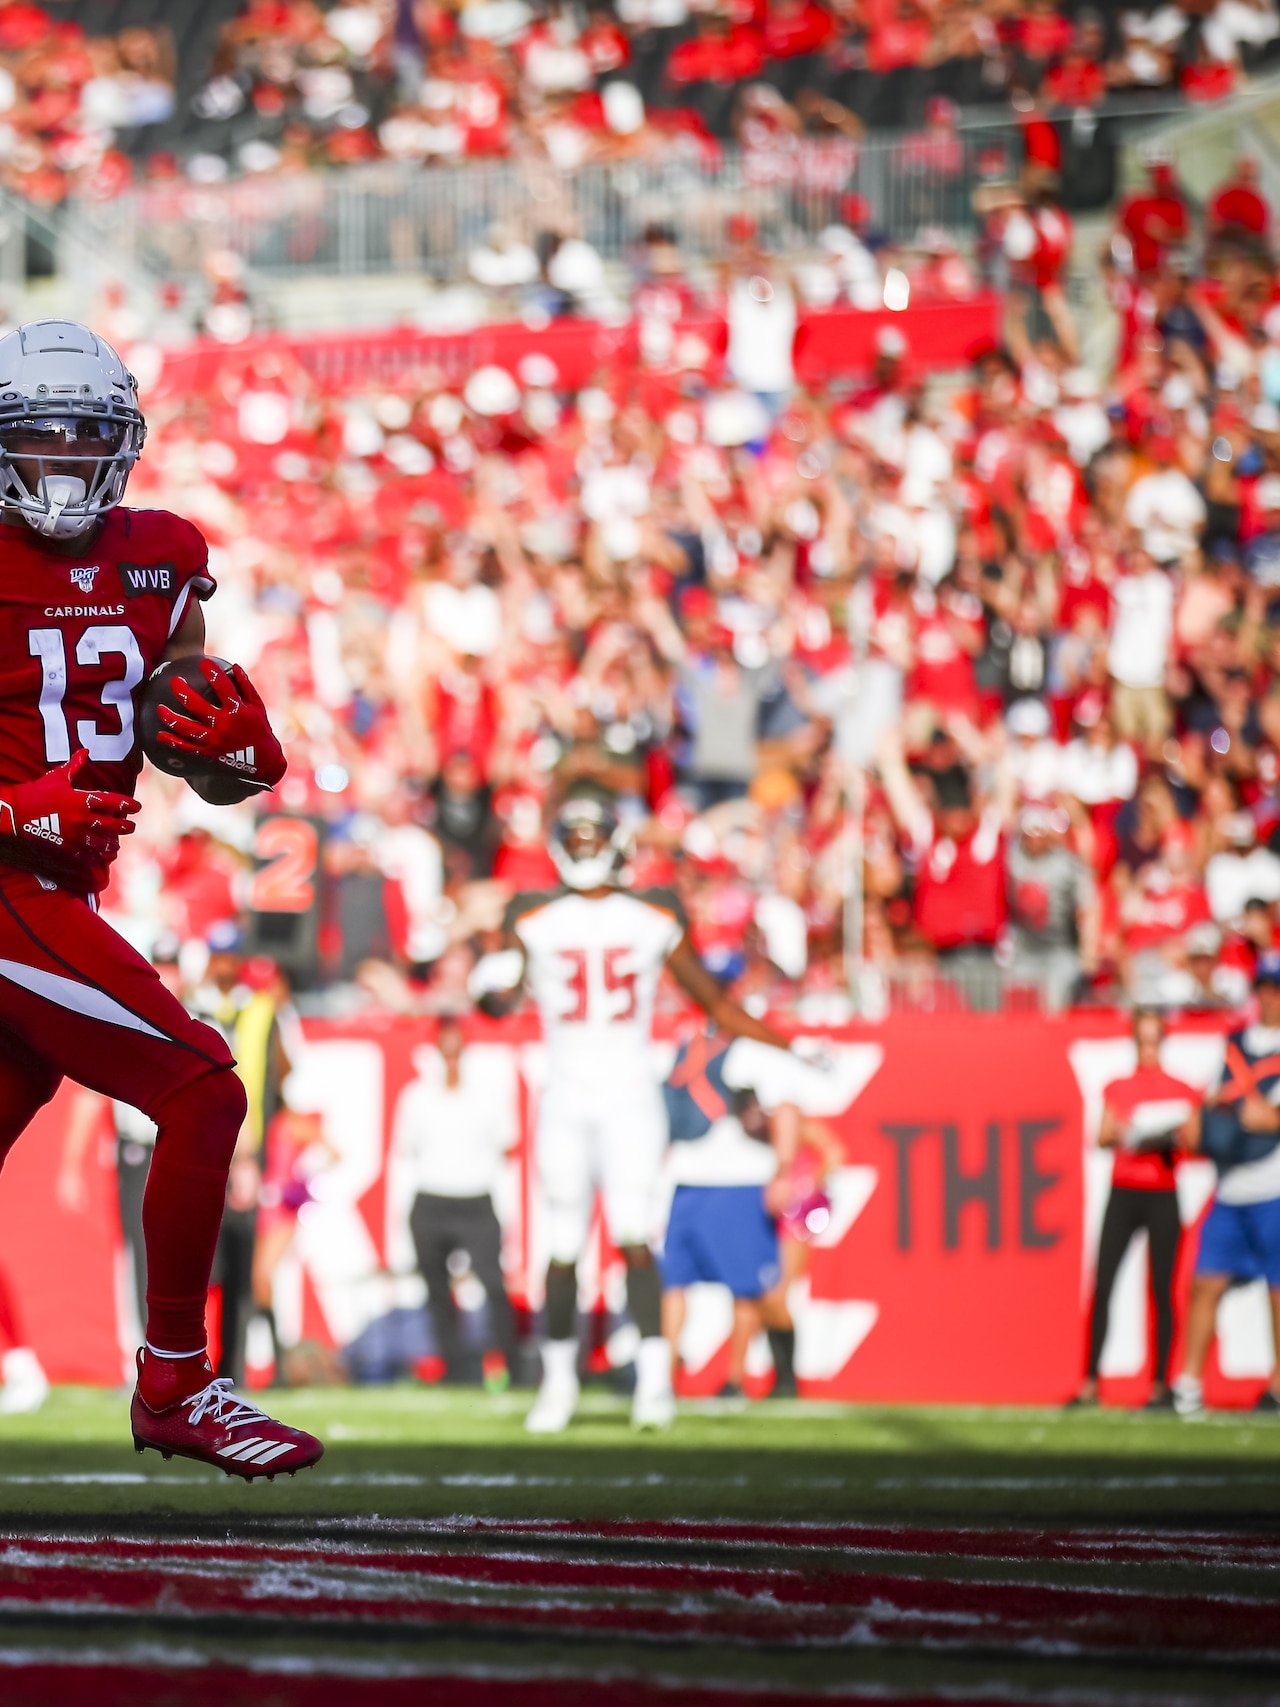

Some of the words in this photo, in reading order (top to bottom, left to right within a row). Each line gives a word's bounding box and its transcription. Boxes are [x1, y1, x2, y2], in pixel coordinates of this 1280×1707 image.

[127, 570, 170, 589] WVB
[44, 605, 125, 617] CARDINALS
[28, 625, 145, 763] 13
[218, 755, 257, 774] adidas
[22, 823, 64, 846] adidas
[253, 817, 318, 913] 2
[556, 946, 639, 1023] 35
[878, 1119, 1063, 1251] THE
